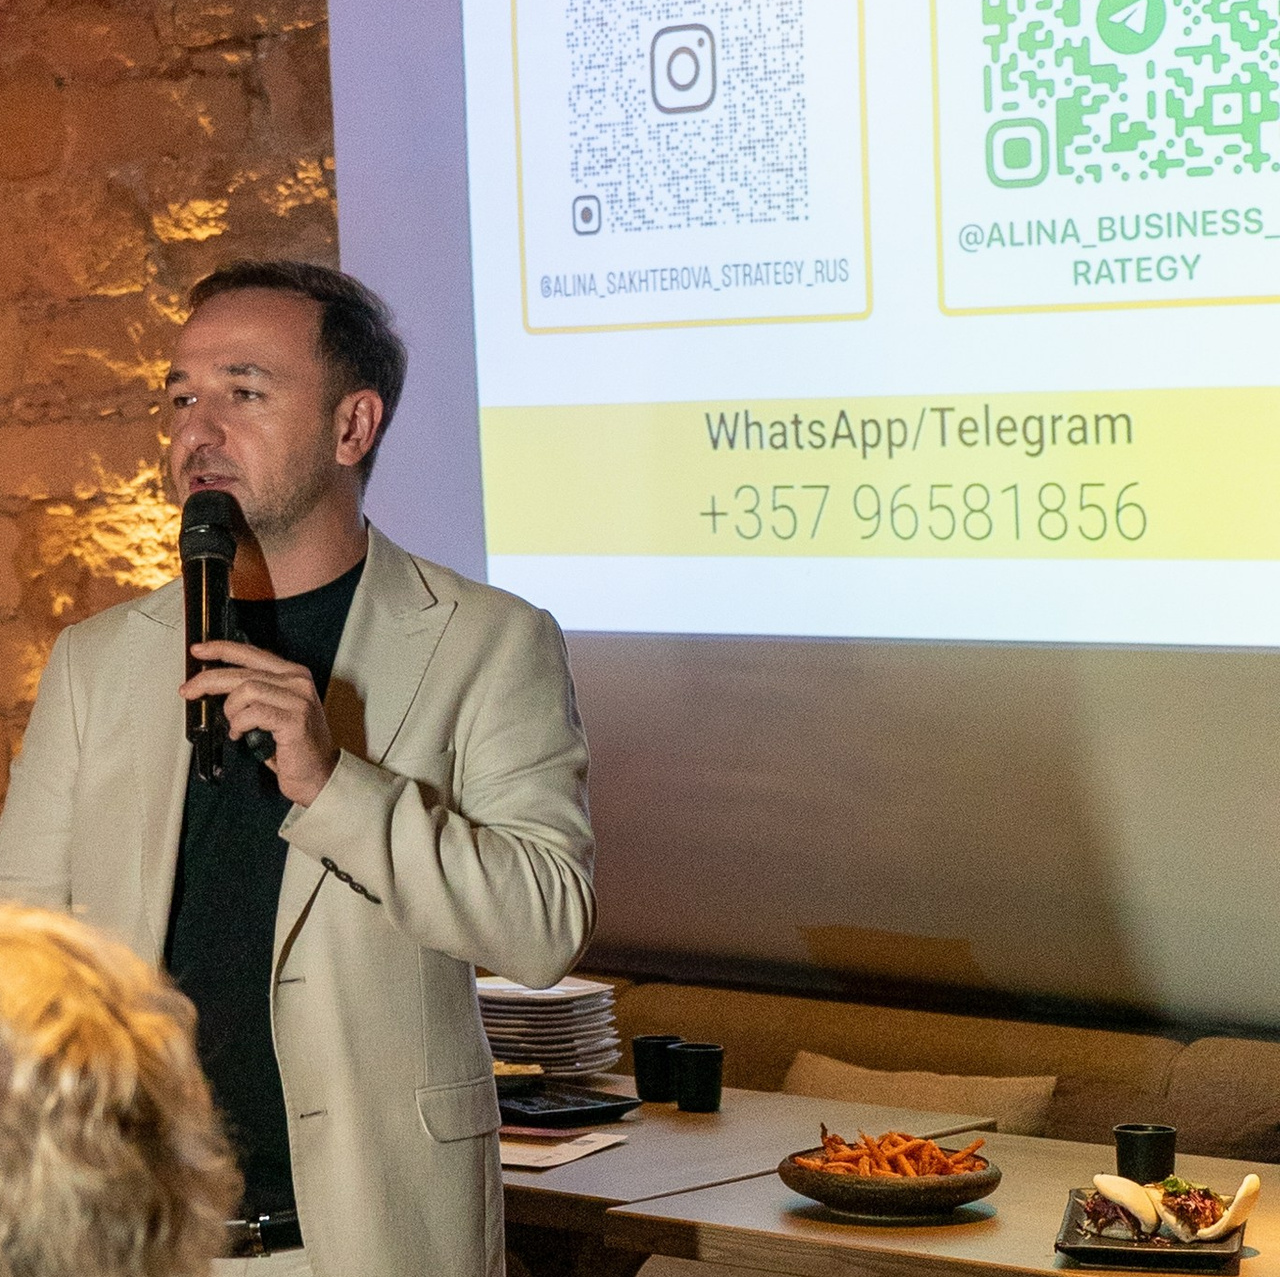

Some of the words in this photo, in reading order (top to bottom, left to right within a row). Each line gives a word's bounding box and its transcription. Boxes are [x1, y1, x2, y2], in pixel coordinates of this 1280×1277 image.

[959, 207, 1280, 253] @ALINA_BUSINESS_
[540, 258, 850, 299] @ALINA_SAKHTEROVA_STRATEGY_RUS
[1073, 254, 1201, 286] RATEGY
[705, 404, 1134, 459] WhatsApp/Telegram
[700, 483, 830, 540] +357
[853, 482, 1147, 541] 96581856
